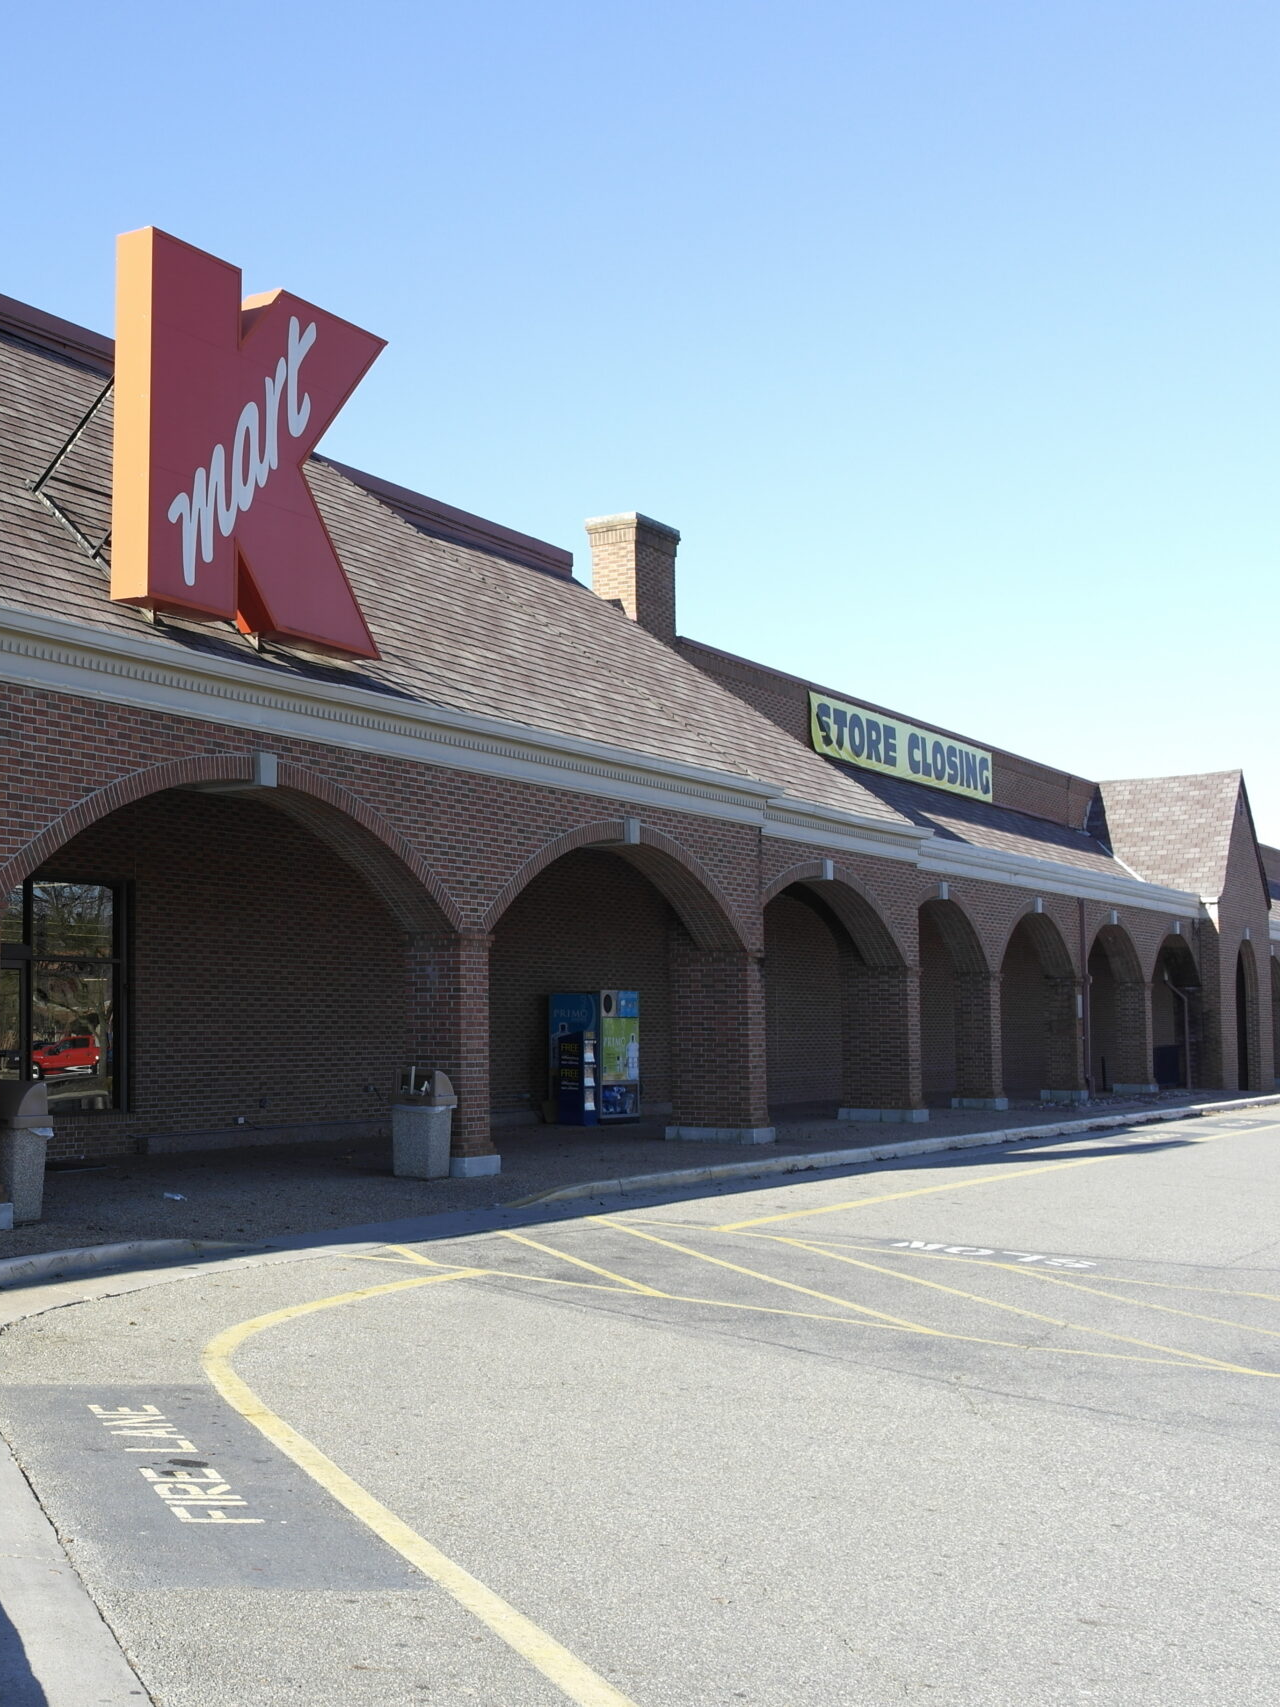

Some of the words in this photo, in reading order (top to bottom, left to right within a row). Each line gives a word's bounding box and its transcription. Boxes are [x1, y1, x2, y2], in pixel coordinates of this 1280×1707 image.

[111, 226, 388, 660] K
[168, 315, 317, 587] mart
[816, 702, 897, 768] STORE
[907, 732, 991, 795] CLOSING
[553, 1009, 588, 1018] PRIMO
[561, 1043, 578, 1052] FREE
[561, 1069, 578, 1078] FREE
[889, 1240, 1098, 1269] SLOW
[87, 1404, 199, 1453] LANE
[138, 1467, 265, 1525] FIRE
